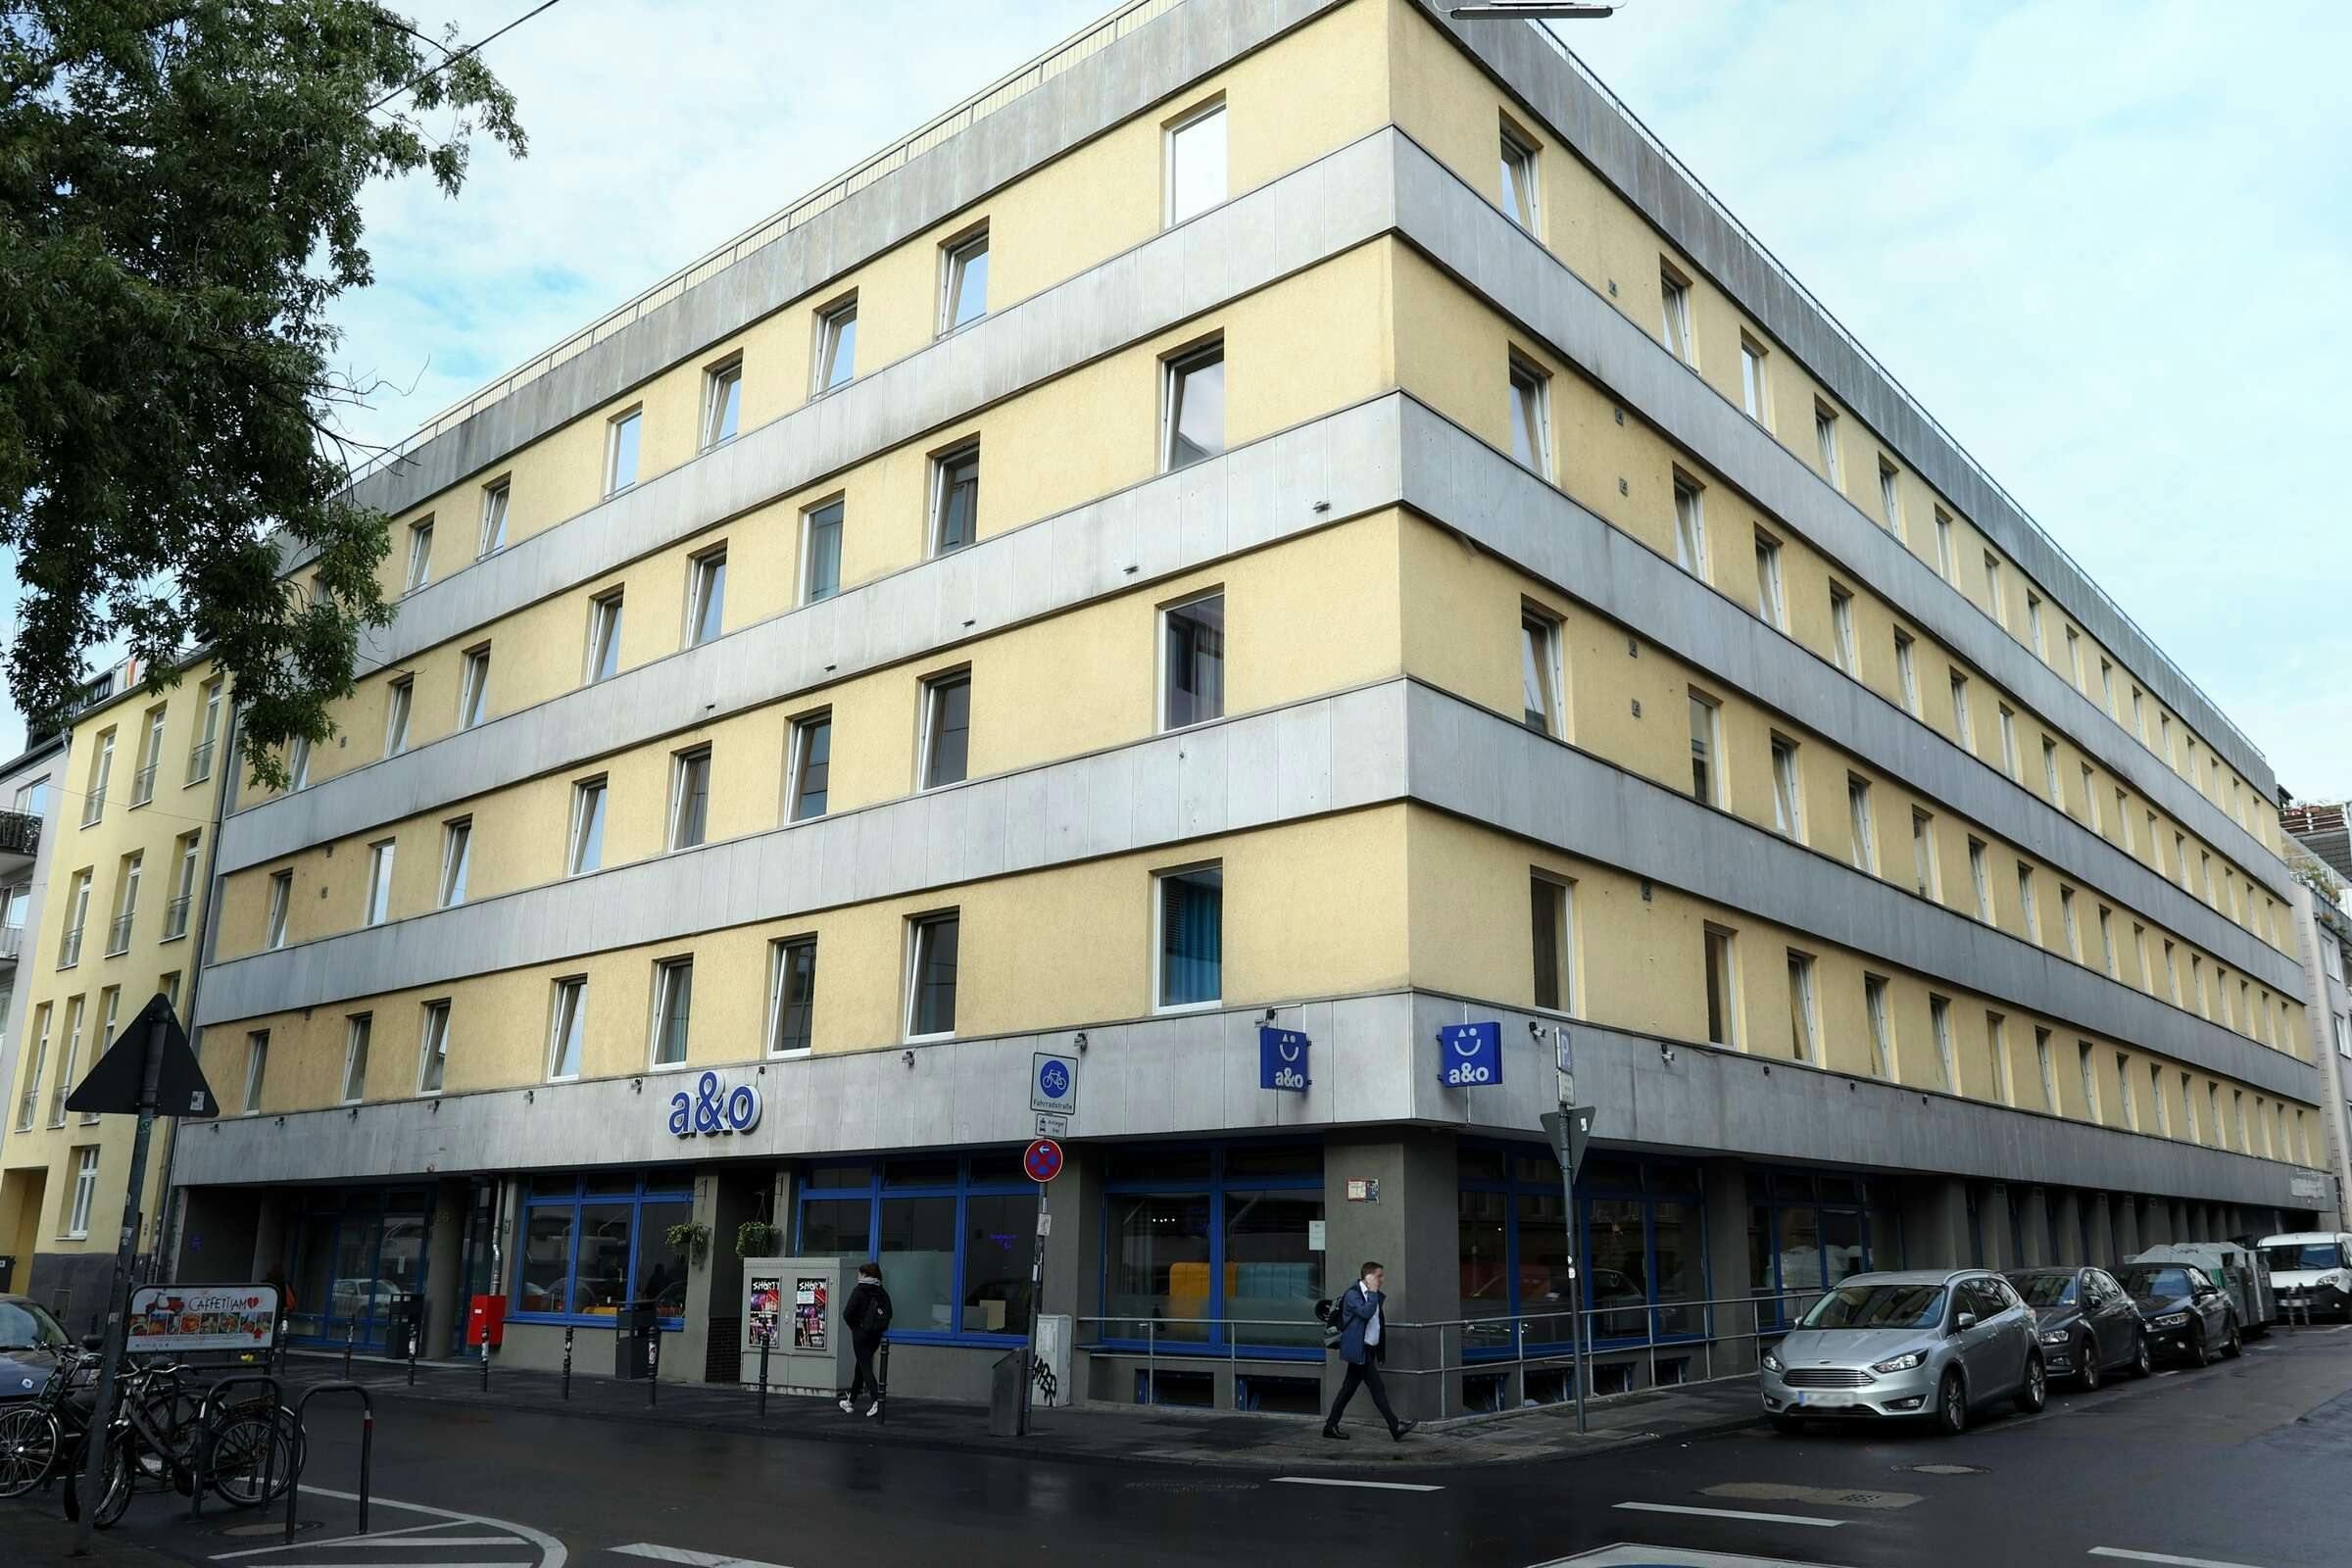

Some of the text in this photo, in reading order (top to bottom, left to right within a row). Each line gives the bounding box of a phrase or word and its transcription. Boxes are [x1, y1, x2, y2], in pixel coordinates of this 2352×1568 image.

[1275, 1067, 1303, 1089] a&o
[1449, 1062, 1490, 1084] a&o
[668, 1070, 760, 1135] a&o
[1033, 1099, 1073, 1110] Fahrradstraße
